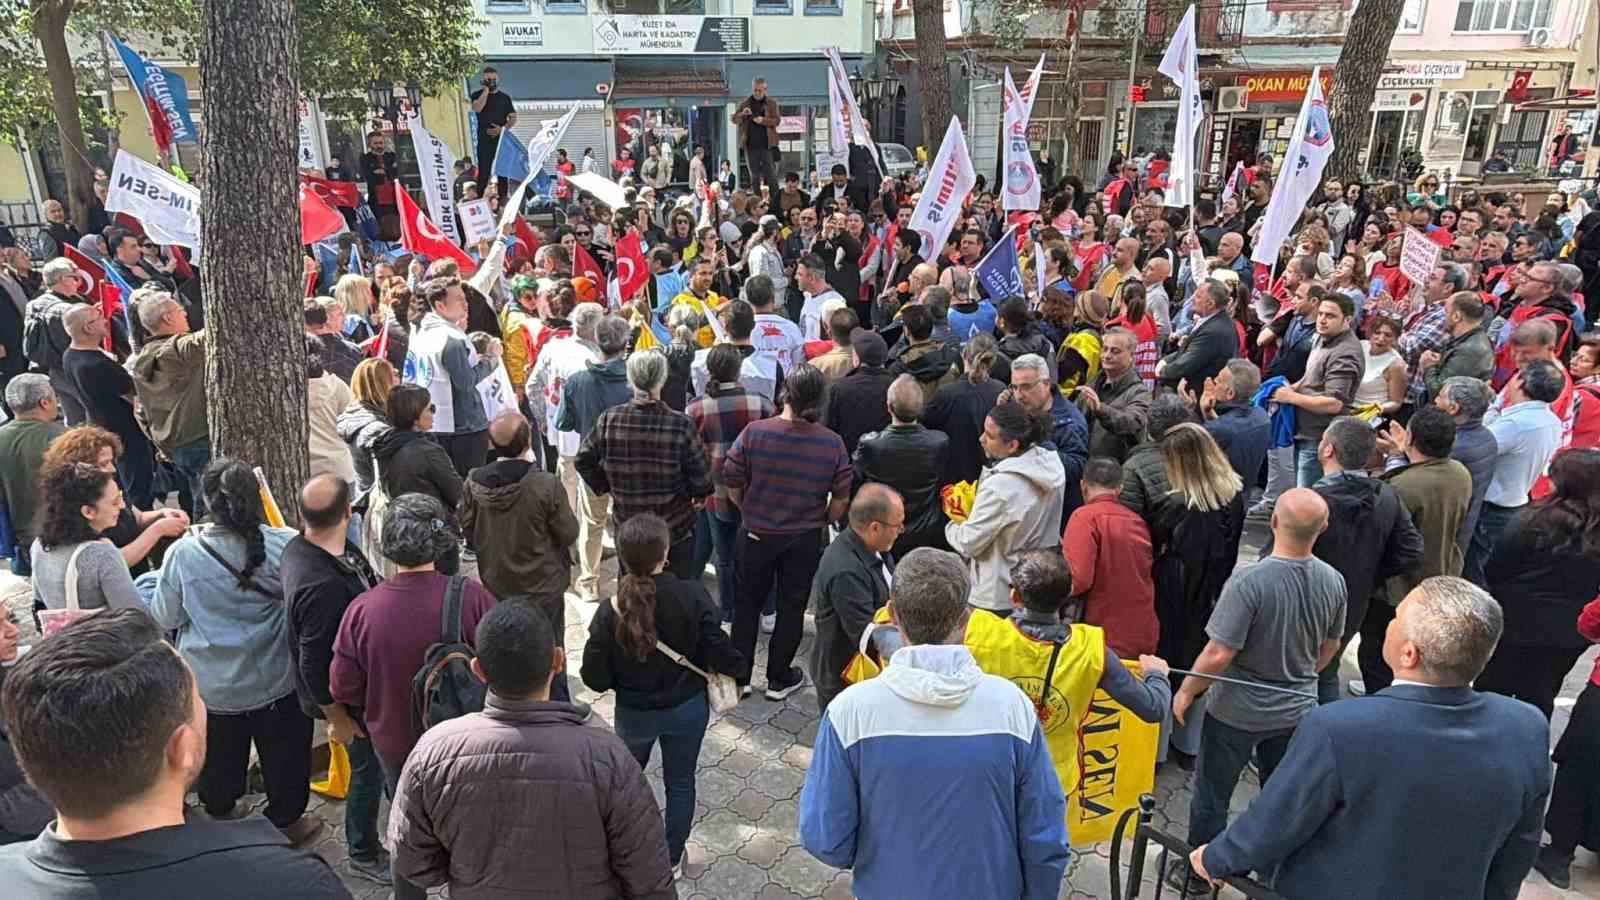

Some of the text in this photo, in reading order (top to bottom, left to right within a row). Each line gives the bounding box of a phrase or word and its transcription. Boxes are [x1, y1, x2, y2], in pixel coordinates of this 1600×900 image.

[505, 26, 539, 36] AVUKAT
[1248, 76, 1329, 92] OKAN MÜZK
